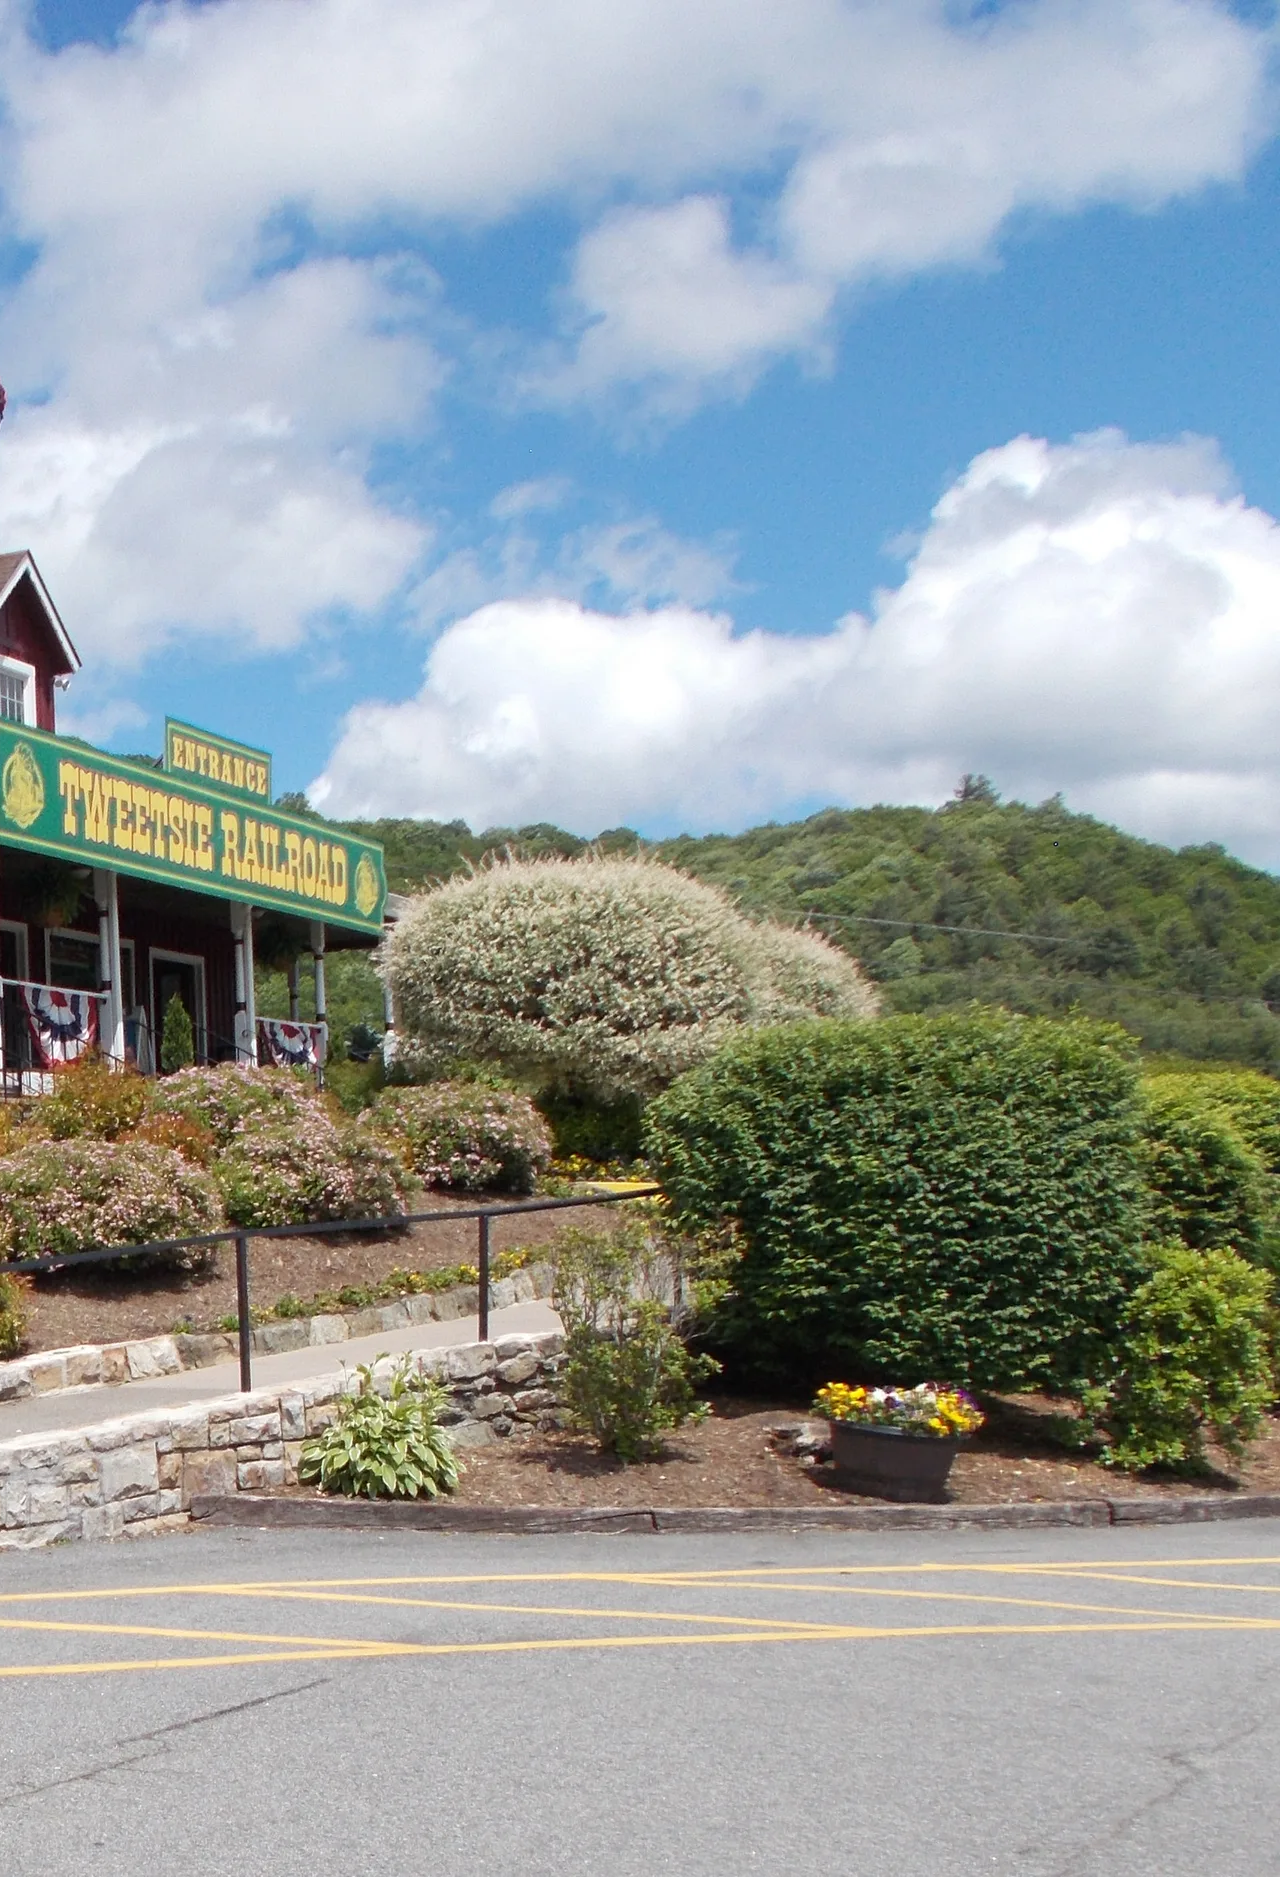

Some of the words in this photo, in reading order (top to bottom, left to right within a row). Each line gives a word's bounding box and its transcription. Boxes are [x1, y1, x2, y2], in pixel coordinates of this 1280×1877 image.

[172, 736, 268, 796] ENTRANCE
[59, 761, 214, 872] TWEETSIE
[221, 810, 350, 907] RAILROAD
